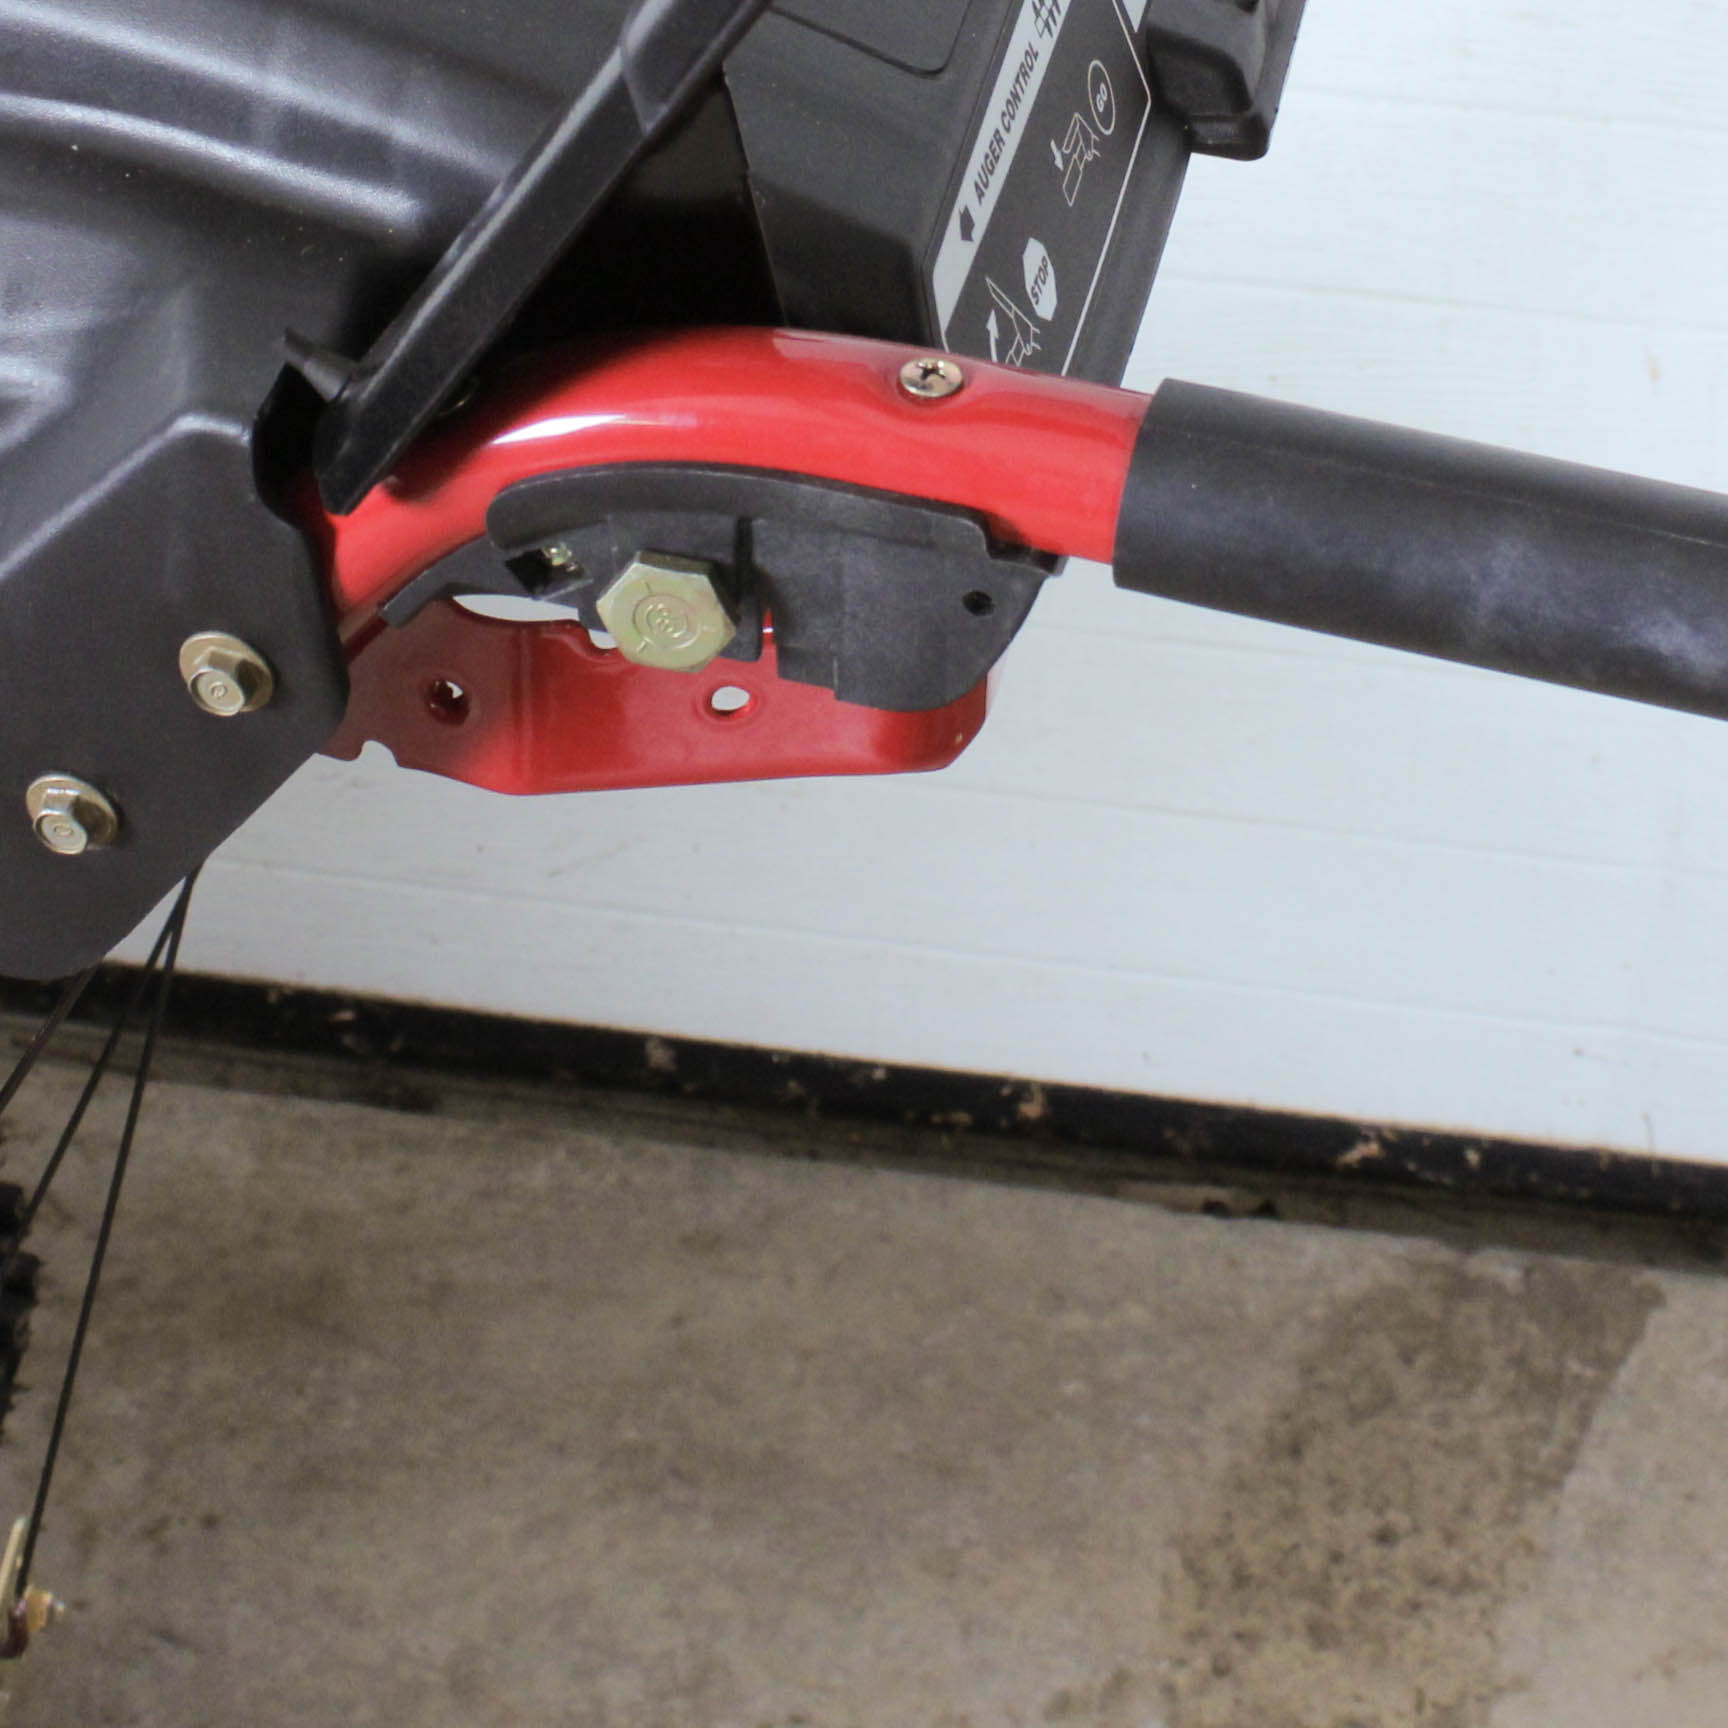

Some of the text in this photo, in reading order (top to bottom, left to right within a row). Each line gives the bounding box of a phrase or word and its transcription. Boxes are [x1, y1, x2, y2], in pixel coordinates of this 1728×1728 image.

[1097, 82, 1108, 112] GO
[973, 41, 1039, 205] AUGER CONTROL
[1031, 255, 1050, 306] STOP
